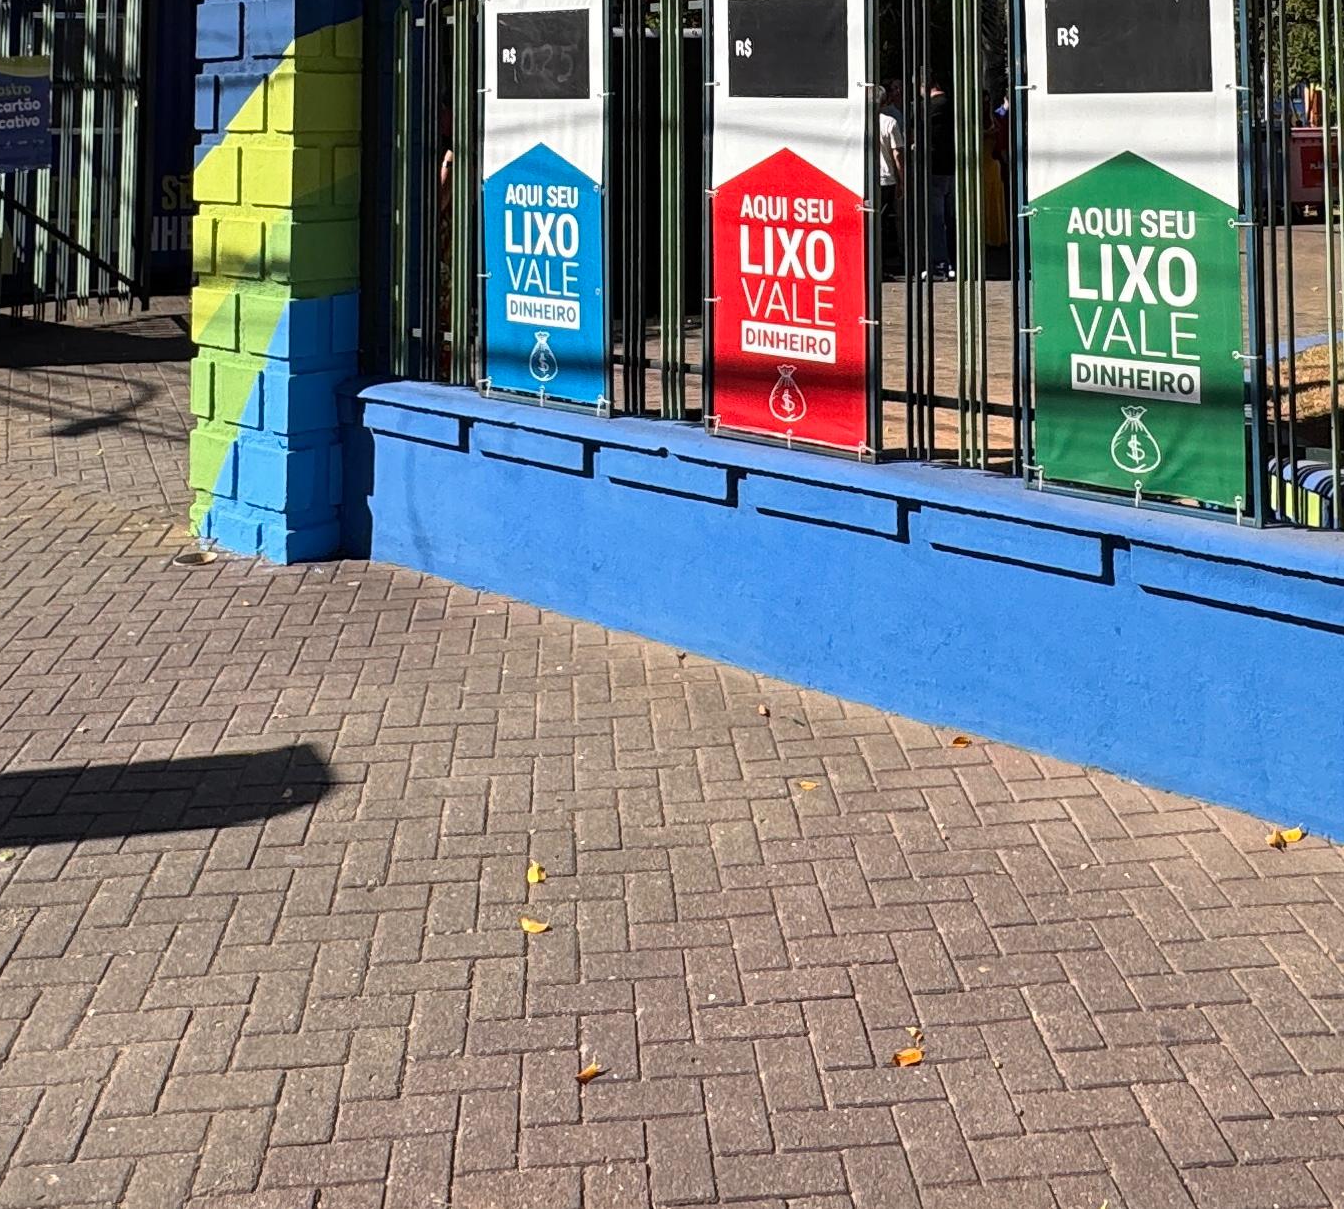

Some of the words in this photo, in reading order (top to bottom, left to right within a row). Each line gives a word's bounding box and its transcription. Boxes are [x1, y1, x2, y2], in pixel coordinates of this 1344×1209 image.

[735, 37, 753, 58] R$
[1057, 24, 1079, 48] R$
[502, 46, 516, 64] R$
[505, 183, 543, 208] AQUI
[546, 185, 579, 209] SEU
[740, 193, 788, 222] AQUI
[793, 197, 834, 224] SEU
[504, 209, 580, 258] LIXO
[1067, 207, 1132, 239] AQUI
[1140, 209, 1196, 240] SEU
[740, 224, 835, 281] LIXO
[505, 256, 580, 297] VALE
[1067, 242, 1198, 307] LIXO
[510, 299, 576, 323] DINHEIRO
[740, 277, 836, 327] VALE
[745, 327, 831, 356] DINHEIRO
[1070, 304, 1200, 361] VALE
[1076, 362, 1195, 395] DINHEIRO
